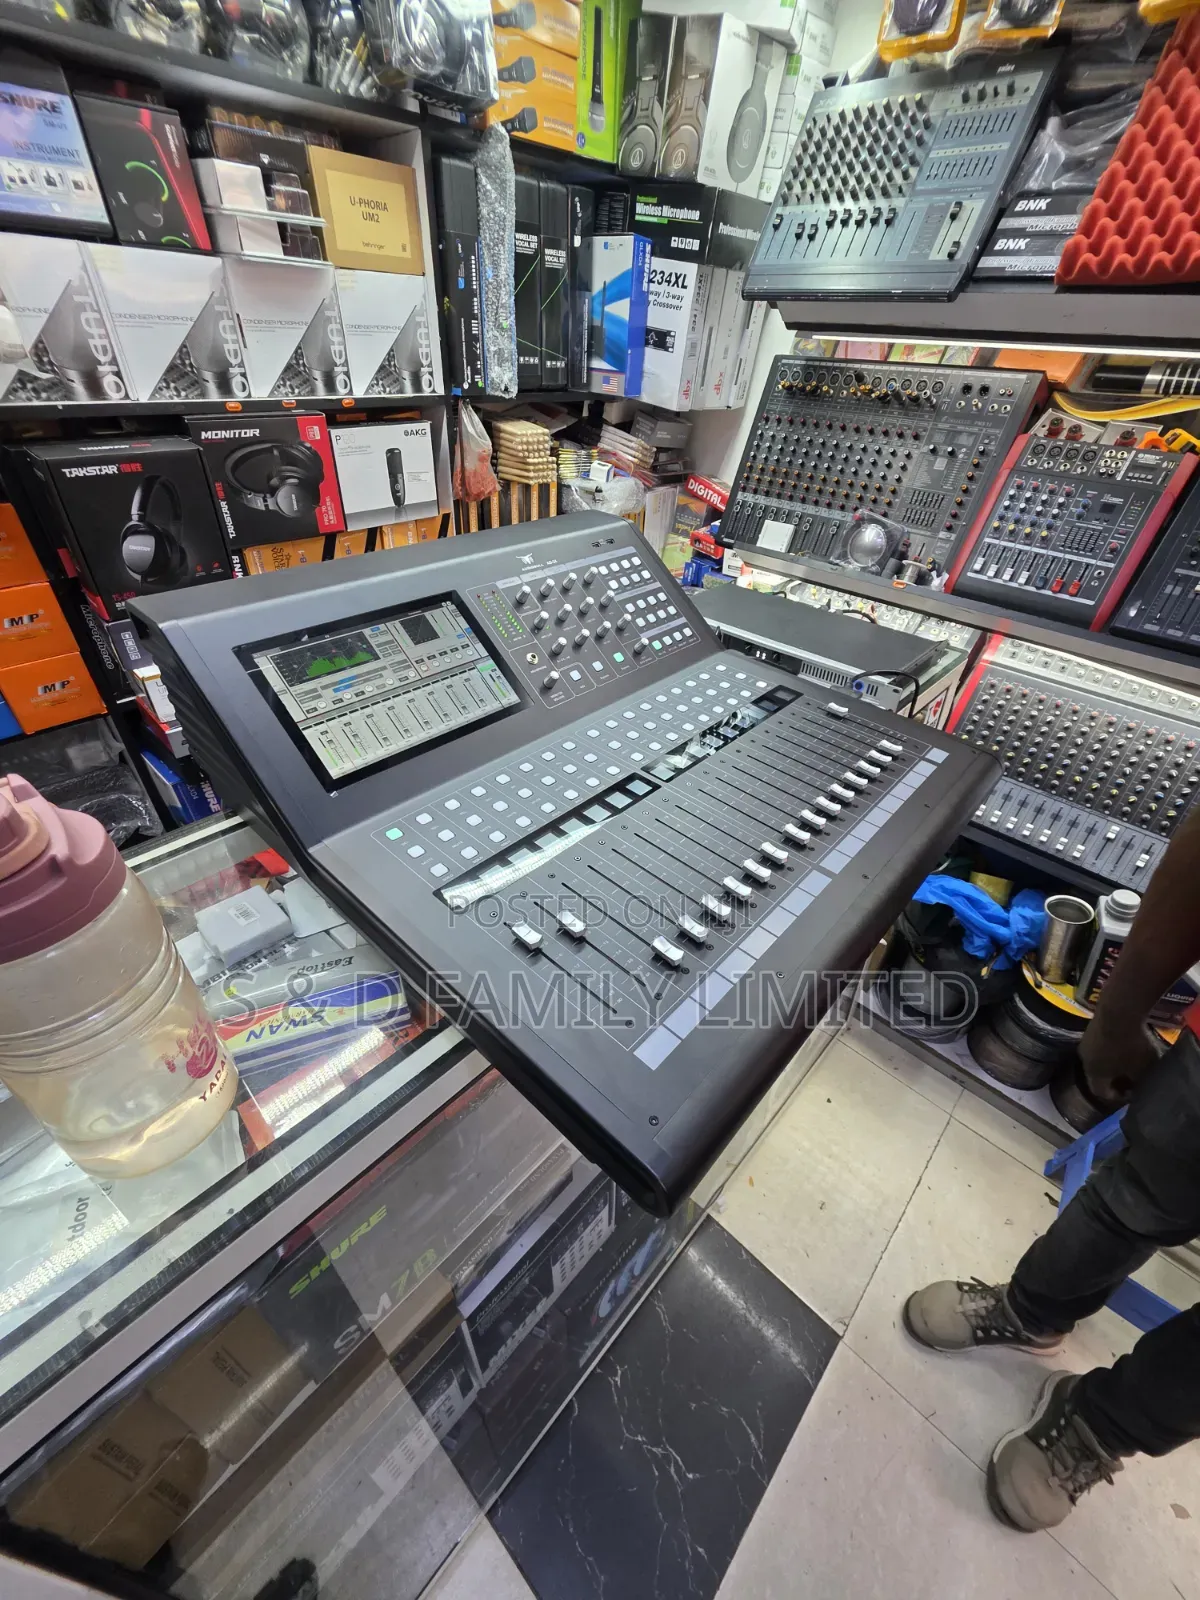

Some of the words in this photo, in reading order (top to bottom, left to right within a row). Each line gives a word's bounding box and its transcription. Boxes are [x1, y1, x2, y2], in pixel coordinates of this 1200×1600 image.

[0, 91, 63, 116] SHURE
[12, 139, 81, 159] INSTRUMENT
[349, 195, 389, 212] U-PHORIA
[635, 202, 662, 216] Wireless
[662, 205, 700, 220] Microphone
[1014, 198, 1052, 212] BNK
[362, 212, 381, 224] UM2
[718, 221, 747, 238] Professional
[1026, 223, 1078, 232] Microph
[515, 232, 538, 242] WIRELESS
[516, 240, 530, 248] VOCAL
[530, 241, 538, 249] SET
[993, 238, 1030, 250] BNK
[362, 241, 386, 251] behringer
[544, 248, 566, 258] WIRELESS
[545, 255, 559, 263] VOCAL
[642, 243, 652, 292] SHURE
[649, 269, 688, 290] 234XL
[665, 291, 685, 303] 3-way
[652, 299, 683, 311] Crossover
[111, 312, 154, 321] CONDENSER
[154, 313, 196, 322] MICROPHONE
[276, 318, 309, 327] MICROPHONE
[682, 379, 692, 401] dbx
[714, 371, 725, 396] dbx
[200, 428, 260, 440] MONITOR
[410, 428, 427, 437] AKG
[61, 463, 119, 478] TAKSTAR
[687, 478, 722, 508] DIGITAL
[321, 505, 327, 513] 70
[220, 500, 237, 539] TAKSTAR
[80, 603, 115, 670] Microphone
[296, 955, 355, 976] Easttop
[245, 1009, 326, 1042] SWAN
[288, 1204, 388, 1299] SHURE
[333, 1247, 437, 1355] SM7B
